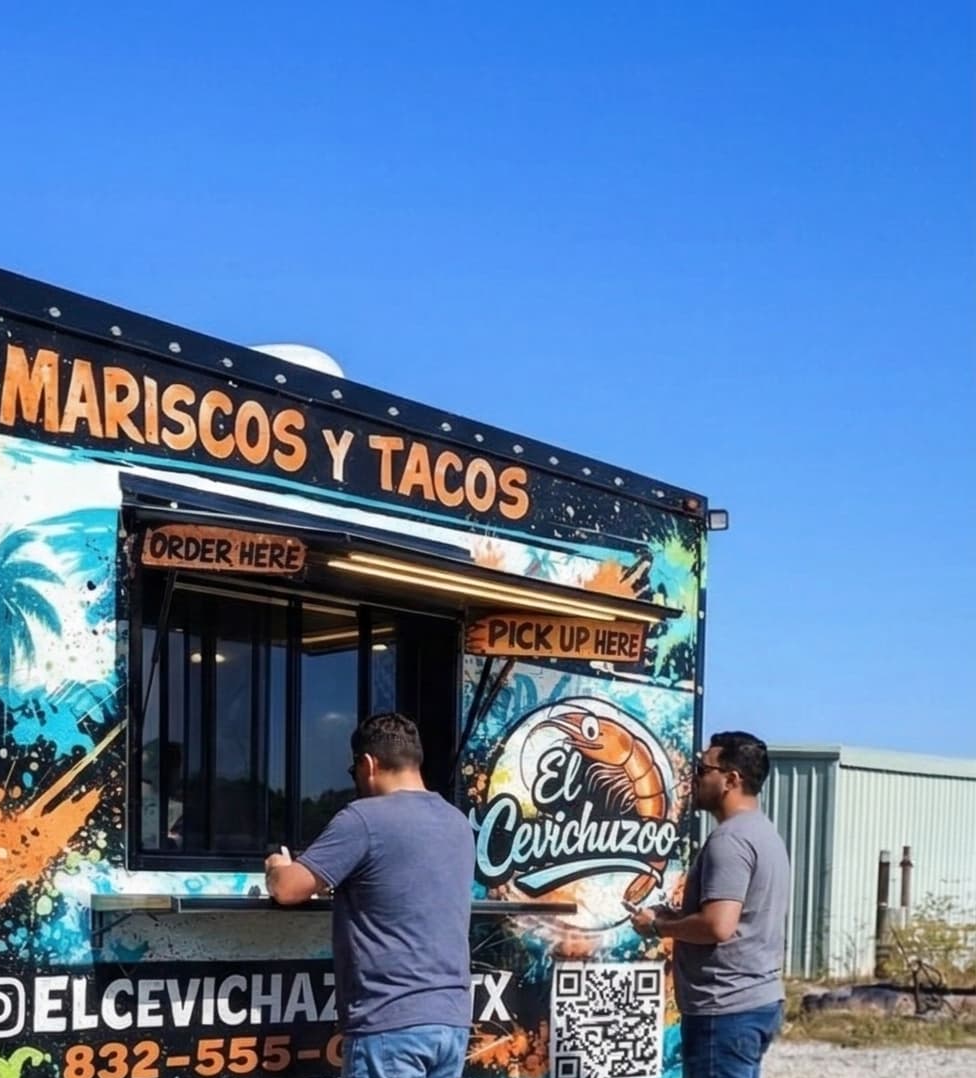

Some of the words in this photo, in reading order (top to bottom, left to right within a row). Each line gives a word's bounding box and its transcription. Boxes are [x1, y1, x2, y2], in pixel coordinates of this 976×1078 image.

[0, 344, 308, 472] MARISCOS
[323, 429, 354, 482] Y
[370, 436, 530, 520] TACOS
[150, 532, 233, 565] ORDER
[240, 541, 301, 570] HERE
[488, 619, 554, 651] PICK
[559, 625, 591, 653] UP
[594, 629, 640, 658] HERE
[535, 747, 582, 804] El
